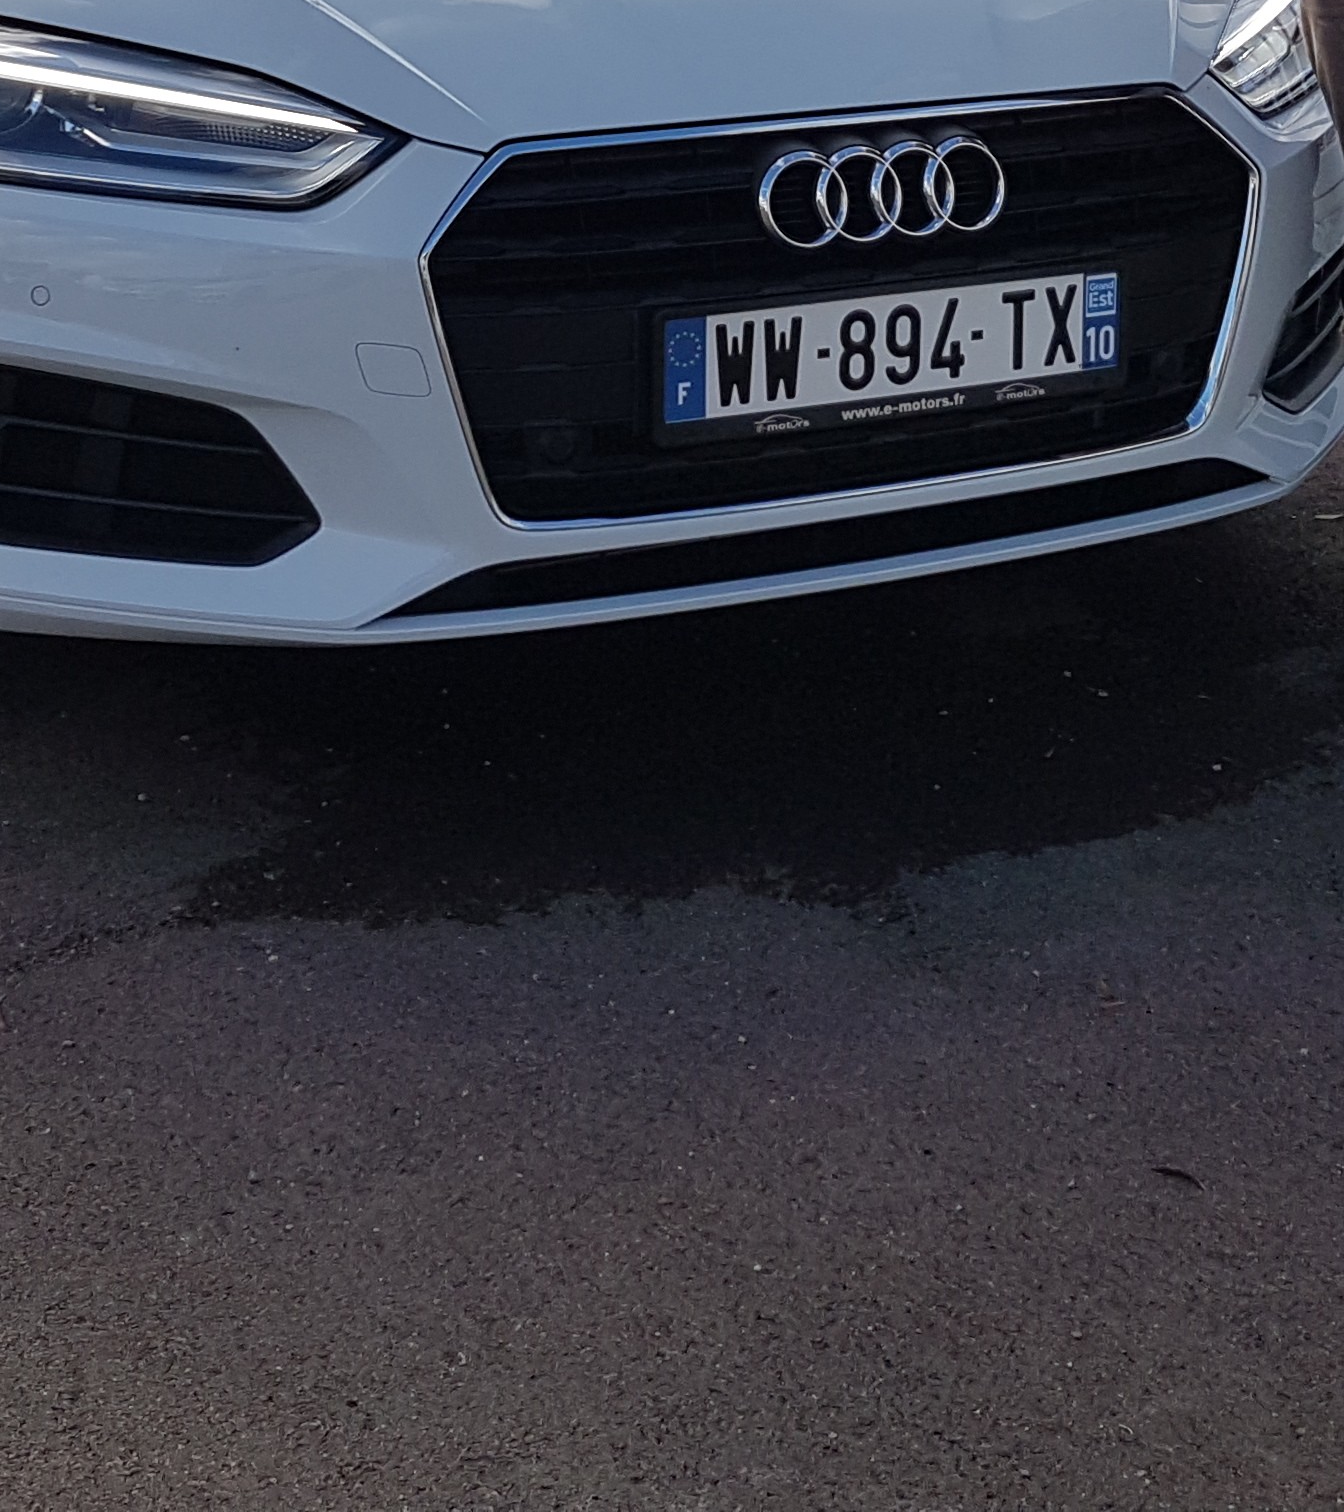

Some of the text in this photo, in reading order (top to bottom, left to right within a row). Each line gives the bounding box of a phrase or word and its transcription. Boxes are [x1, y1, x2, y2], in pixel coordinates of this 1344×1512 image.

[1089, 280, 1114, 291] Grand
[1089, 290, 1113, 308] Est
[715, 284, 1078, 408] WW-894-TX
[1086, 325, 1115, 362] 10
[677, 381, 692, 406] F
[841, 393, 966, 421] www.e-motors.fr
